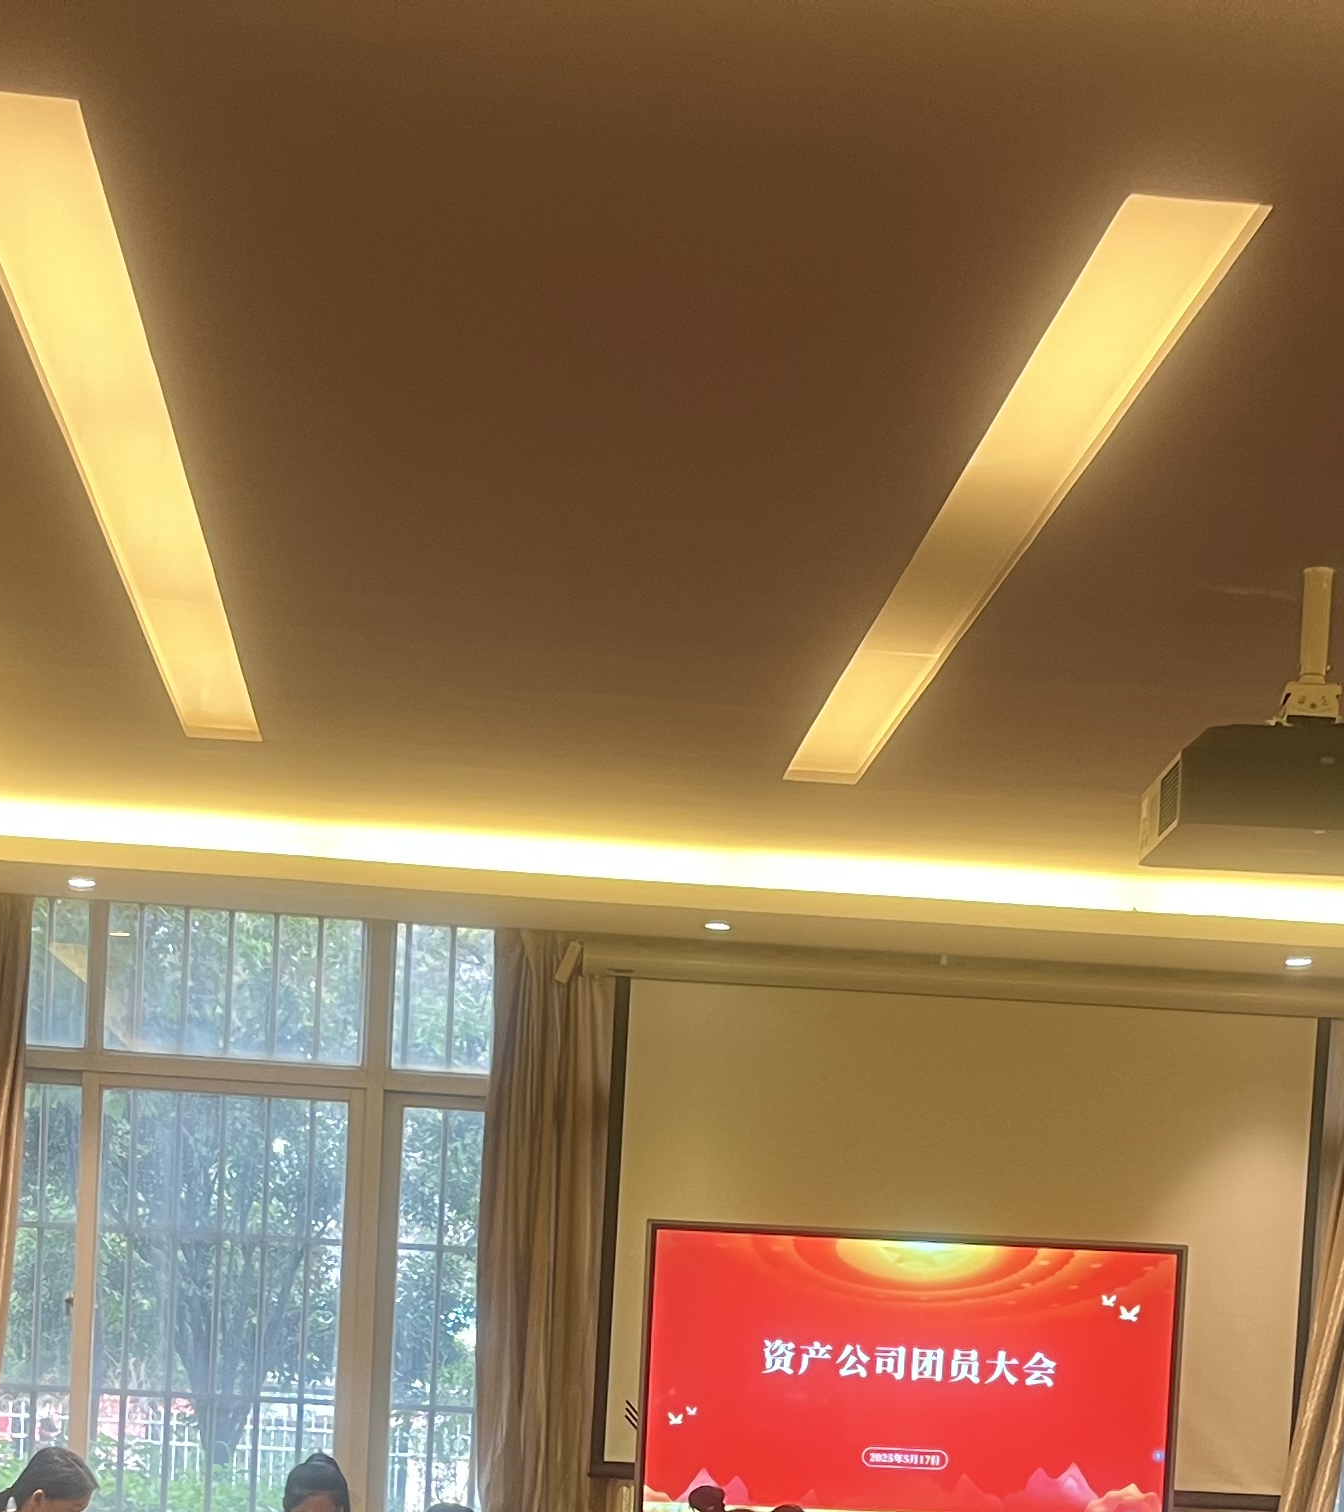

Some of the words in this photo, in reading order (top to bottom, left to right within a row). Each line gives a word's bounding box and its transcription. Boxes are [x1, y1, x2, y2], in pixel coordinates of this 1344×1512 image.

[761, 1338, 1057, 1388] 资产公司团员大会
